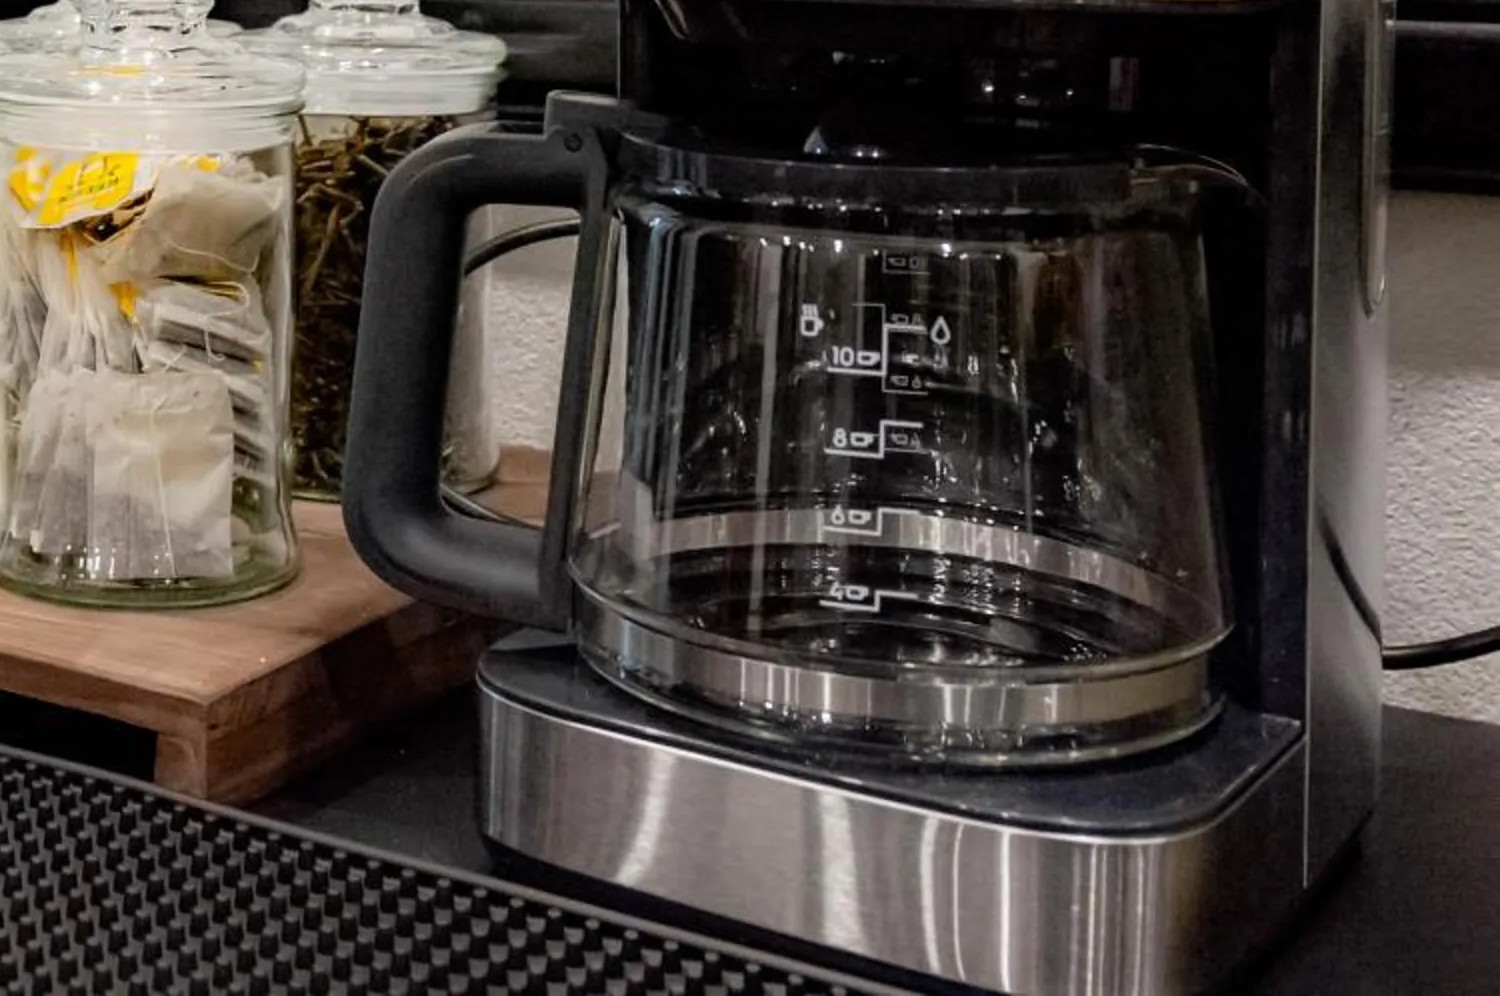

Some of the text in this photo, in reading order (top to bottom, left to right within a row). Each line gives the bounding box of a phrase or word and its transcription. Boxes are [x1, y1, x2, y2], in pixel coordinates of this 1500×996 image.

[831, 346, 855, 367] 10
[832, 427, 847, 448] 8
[831, 504, 845, 525] 6
[829, 581, 843, 601] 4
